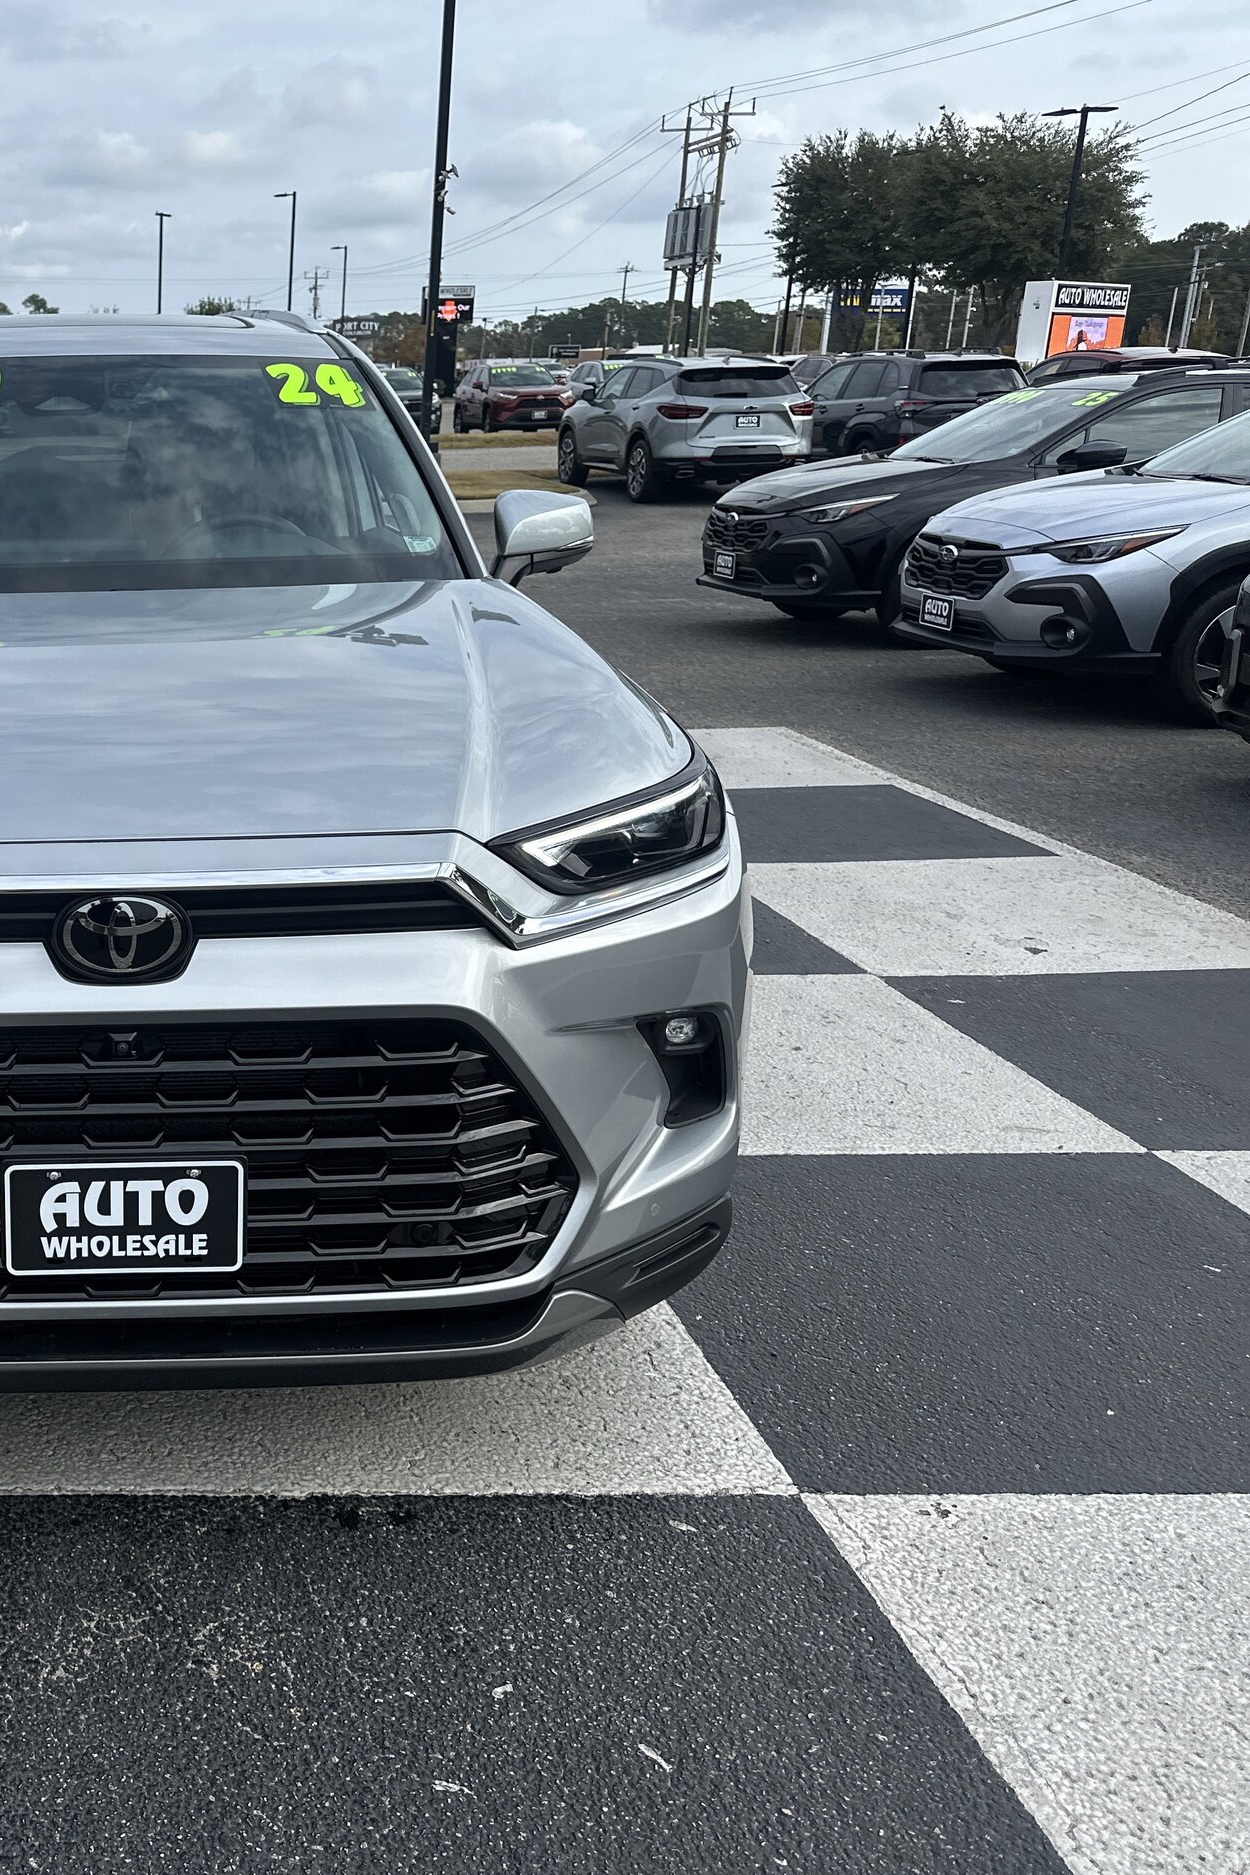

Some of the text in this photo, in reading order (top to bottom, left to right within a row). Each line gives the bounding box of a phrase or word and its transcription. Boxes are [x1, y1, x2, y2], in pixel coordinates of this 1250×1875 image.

[1058, 287, 1128, 307] AUTO WHOLESALE
[360, 321, 380, 331] CITY
[265, 363, 366, 408] 24
[1070, 391, 1120, 407] 25
[738, 416, 758, 424] AUTO
[717, 555, 733, 568] AUTO
[925, 599, 949, 617] AUTO
[39, 1178, 210, 1234] AUTO
[40, 1233, 209, 1260] WHOLESALE
